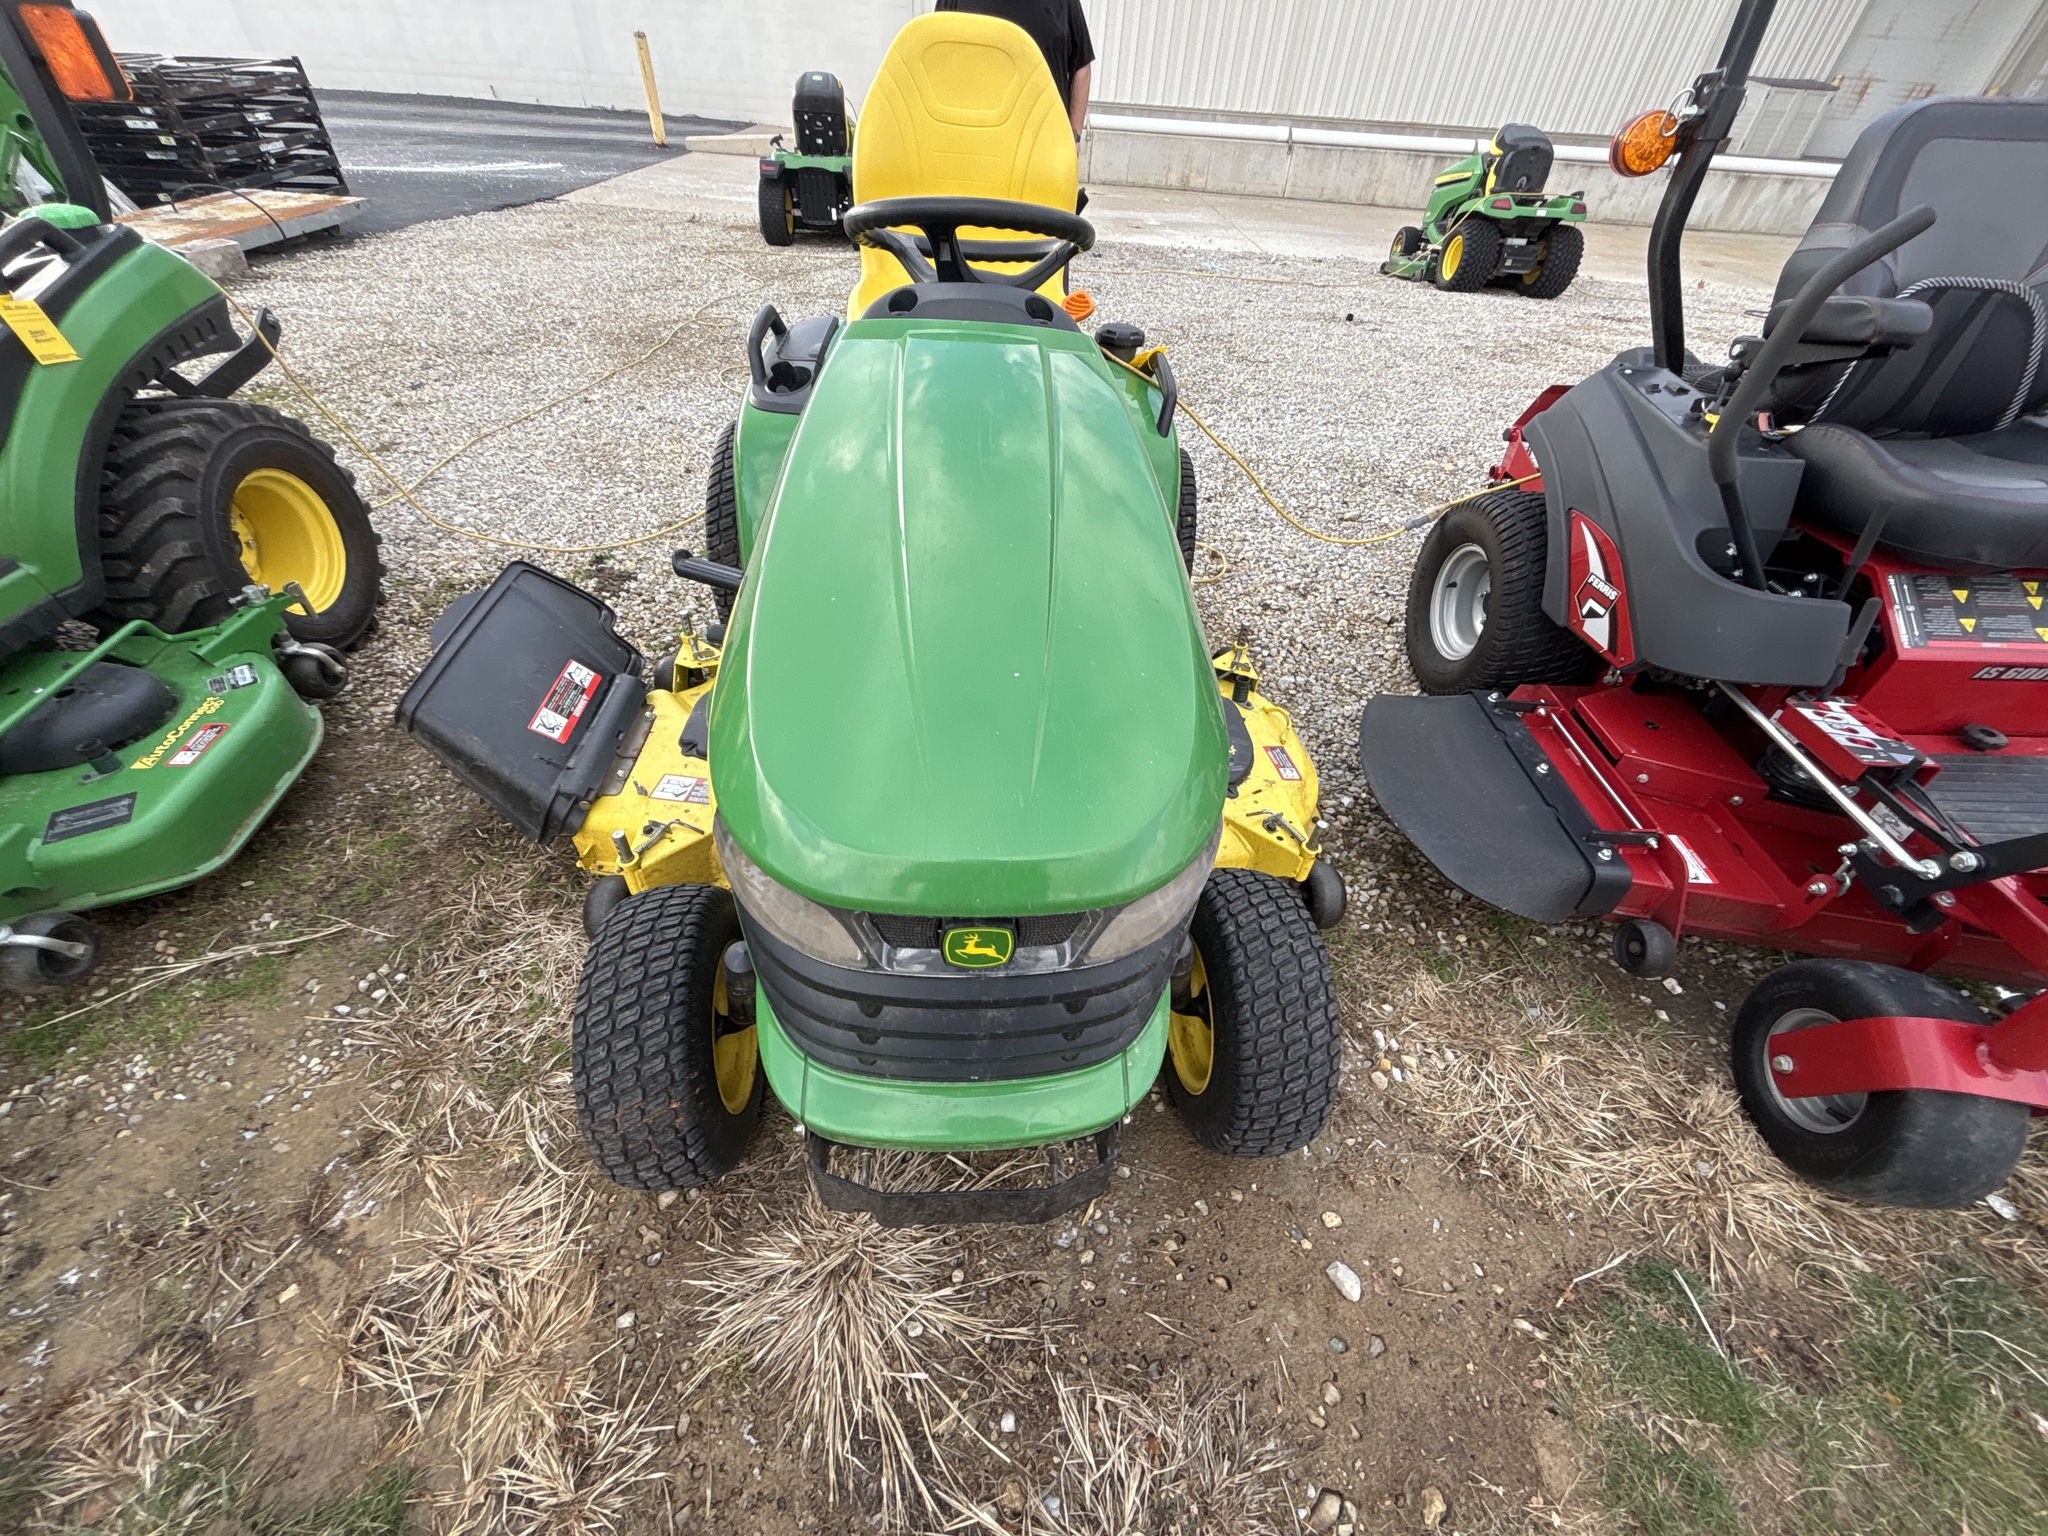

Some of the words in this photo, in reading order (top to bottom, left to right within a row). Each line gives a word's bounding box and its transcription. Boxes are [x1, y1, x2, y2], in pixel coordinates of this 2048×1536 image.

[1587, 574, 1618, 600] FERRIS
[1972, 666, 2006, 679] IS
[1999, 667, 2048, 680] 600
[143, 696, 220, 768] AutoConnect
